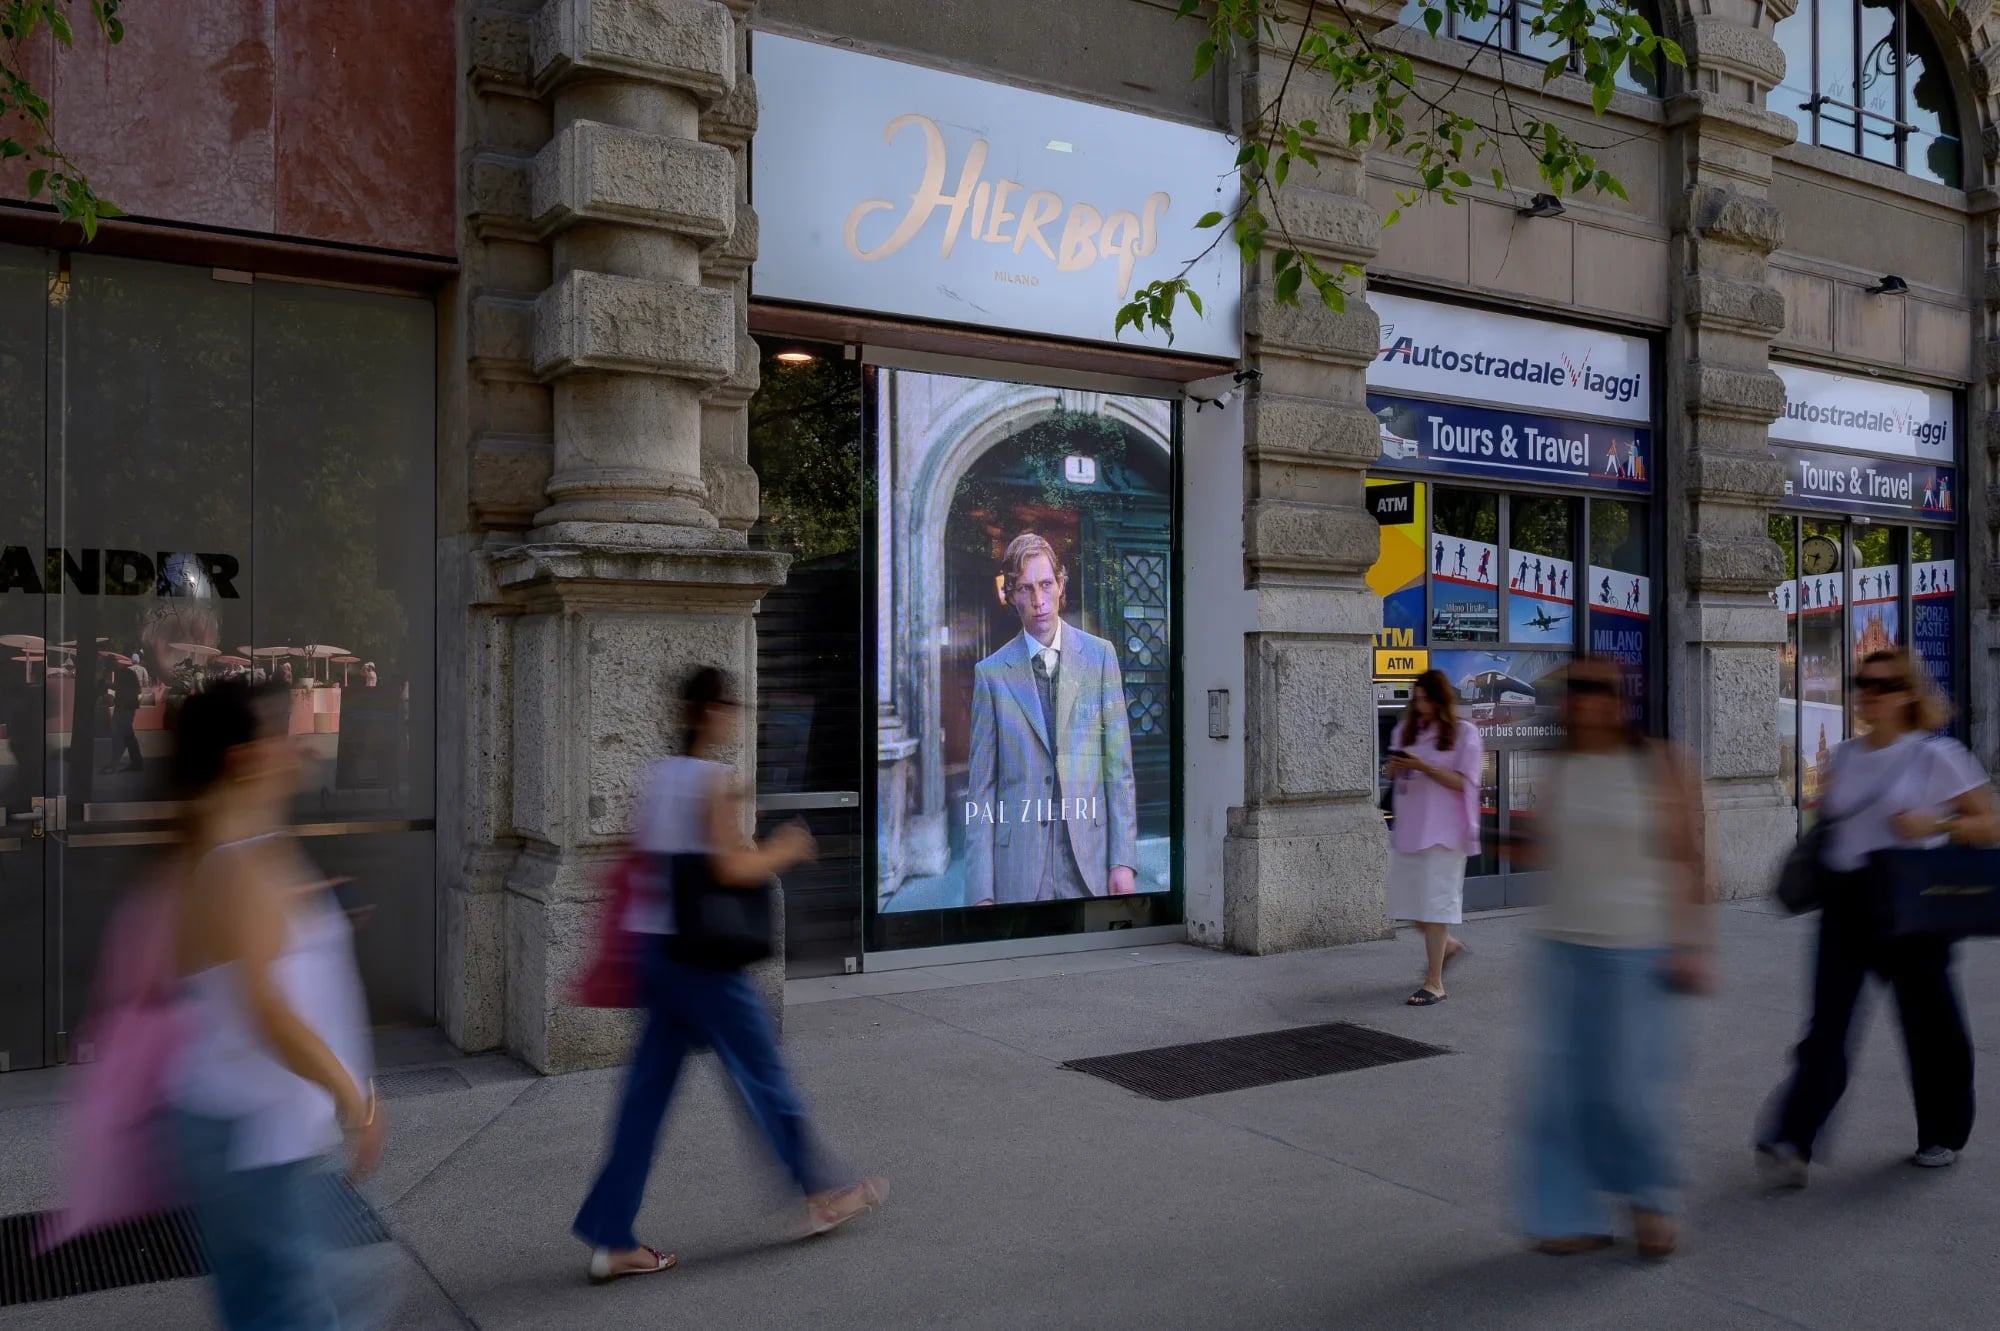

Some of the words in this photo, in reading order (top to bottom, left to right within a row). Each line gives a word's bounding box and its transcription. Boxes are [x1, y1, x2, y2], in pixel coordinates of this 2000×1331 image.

[993, 270, 1040, 287] MILANO
[1784, 396, 1894, 433] utostradale
[1428, 416, 1493, 456] Tours
[1500, 424, 1519, 459] &
[1524, 428, 1589, 466] Travel
[1800, 460, 1845, 493] Tours
[1849, 467, 1862, 495] &
[1866, 468, 1912, 500] Travel
[1377, 497, 1408, 513] ATM
[1915, 605, 1950, 621] SFORZA
[1915, 621, 1950, 637] CASTLE
[1594, 629, 1643, 651] MILANO
[1387, 658, 1414, 670] ATM
[1496, 724, 1513, 737] bus
[1516, 723, 1568, 737] connection
[965, 800, 1010, 825] PAL
[1021, 797, 1097, 822] ZILERI
